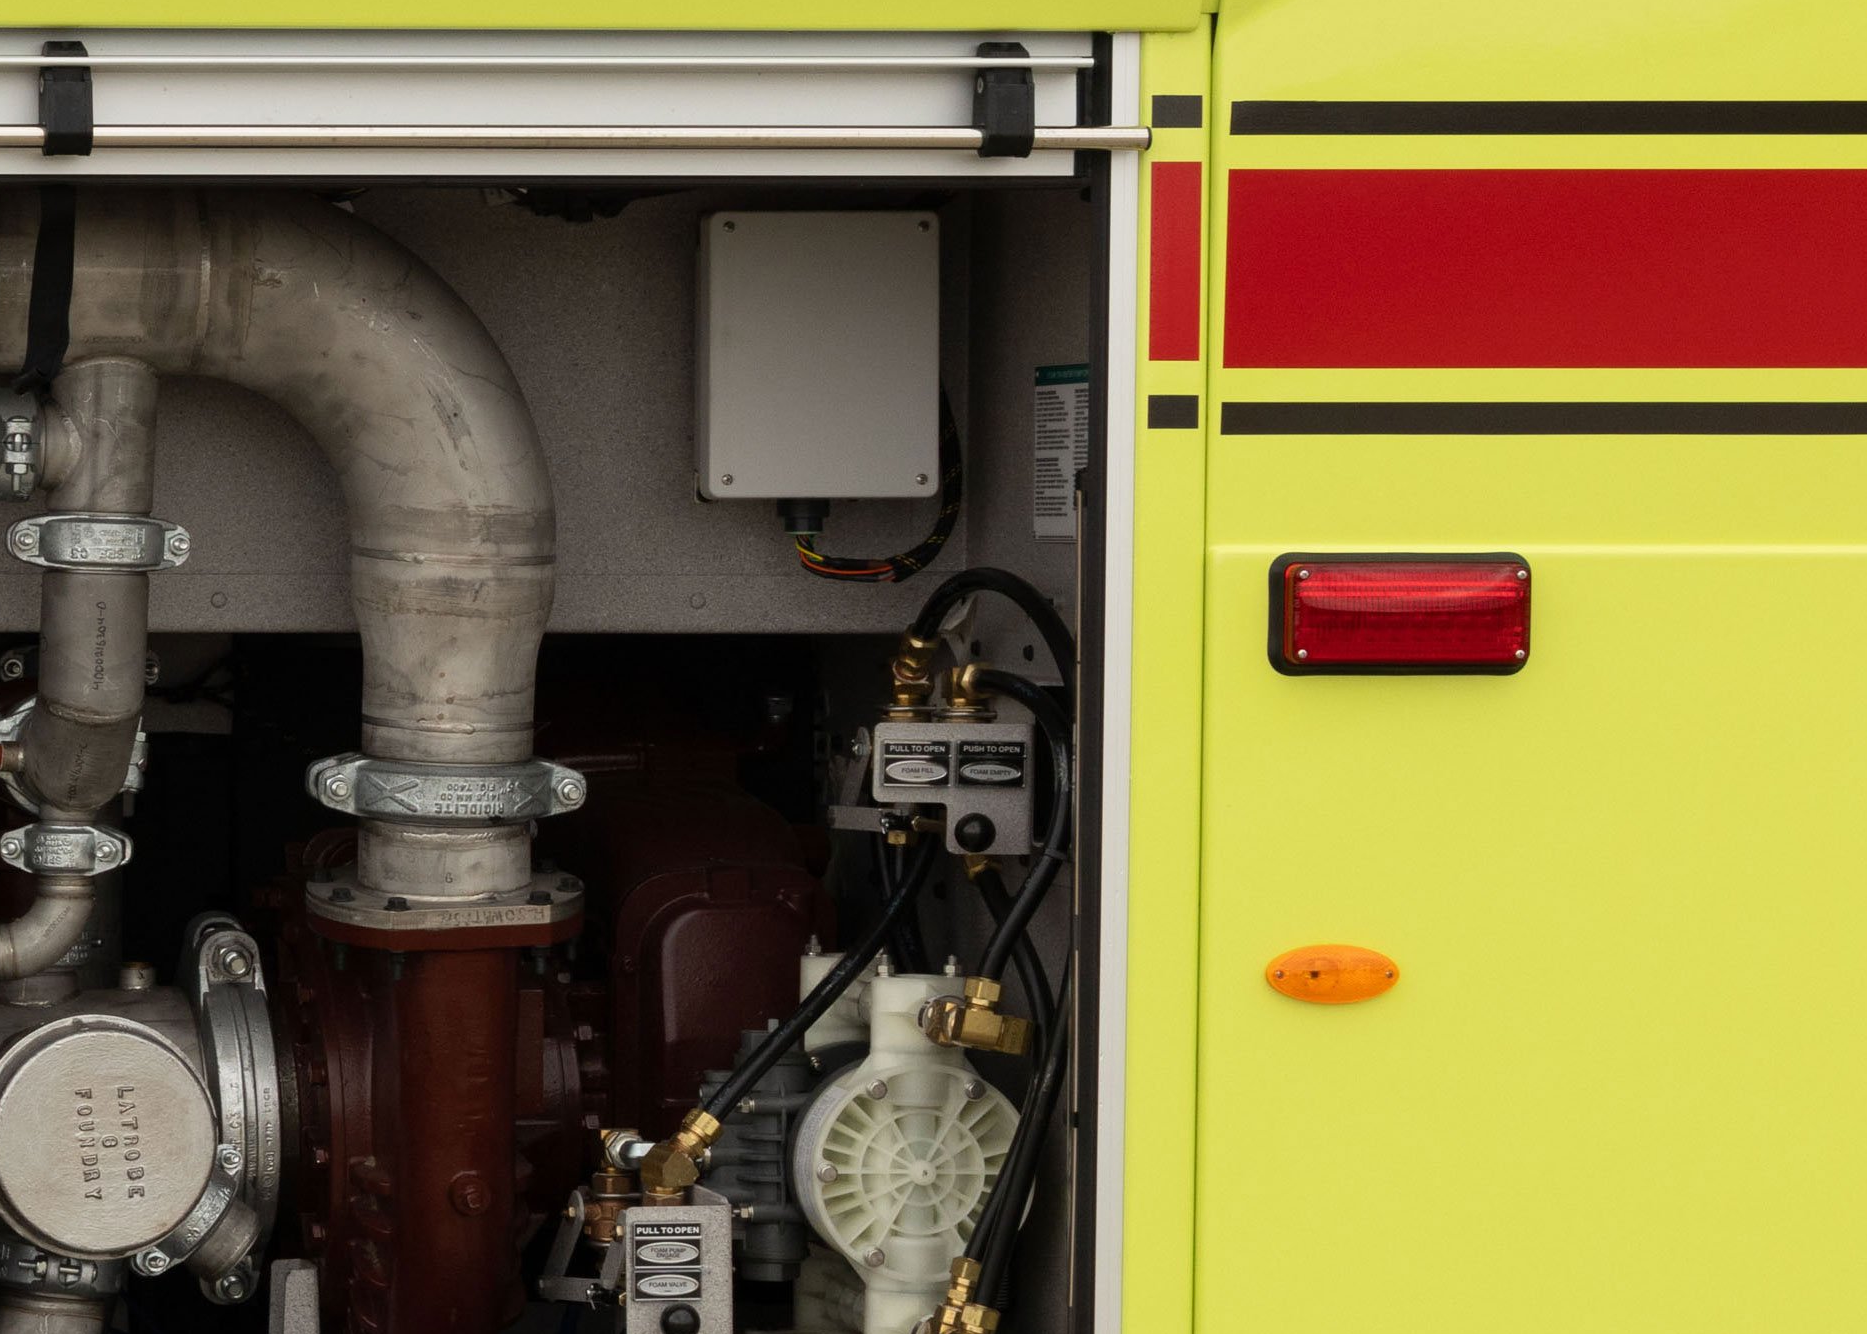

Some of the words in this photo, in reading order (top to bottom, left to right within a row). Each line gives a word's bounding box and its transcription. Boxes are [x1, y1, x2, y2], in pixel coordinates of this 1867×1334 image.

[889, 745, 910, 753] PULL
[911, 745, 922, 753] TO
[923, 745, 946, 753] OPEN
[963, 745, 985, 753] PUSH
[986, 745, 997, 753] TO
[998, 745, 1021, 753] OPEN
[434, 802, 505, 815] RIGIDLITE
[74, 1088, 103, 1200] FOUNDRY
[117, 1086, 145, 1199] LATROBE
[636, 1227, 660, 1235] PULL
[660, 1226, 674, 1234] TO
[674, 1226, 700, 1234] OPEN
